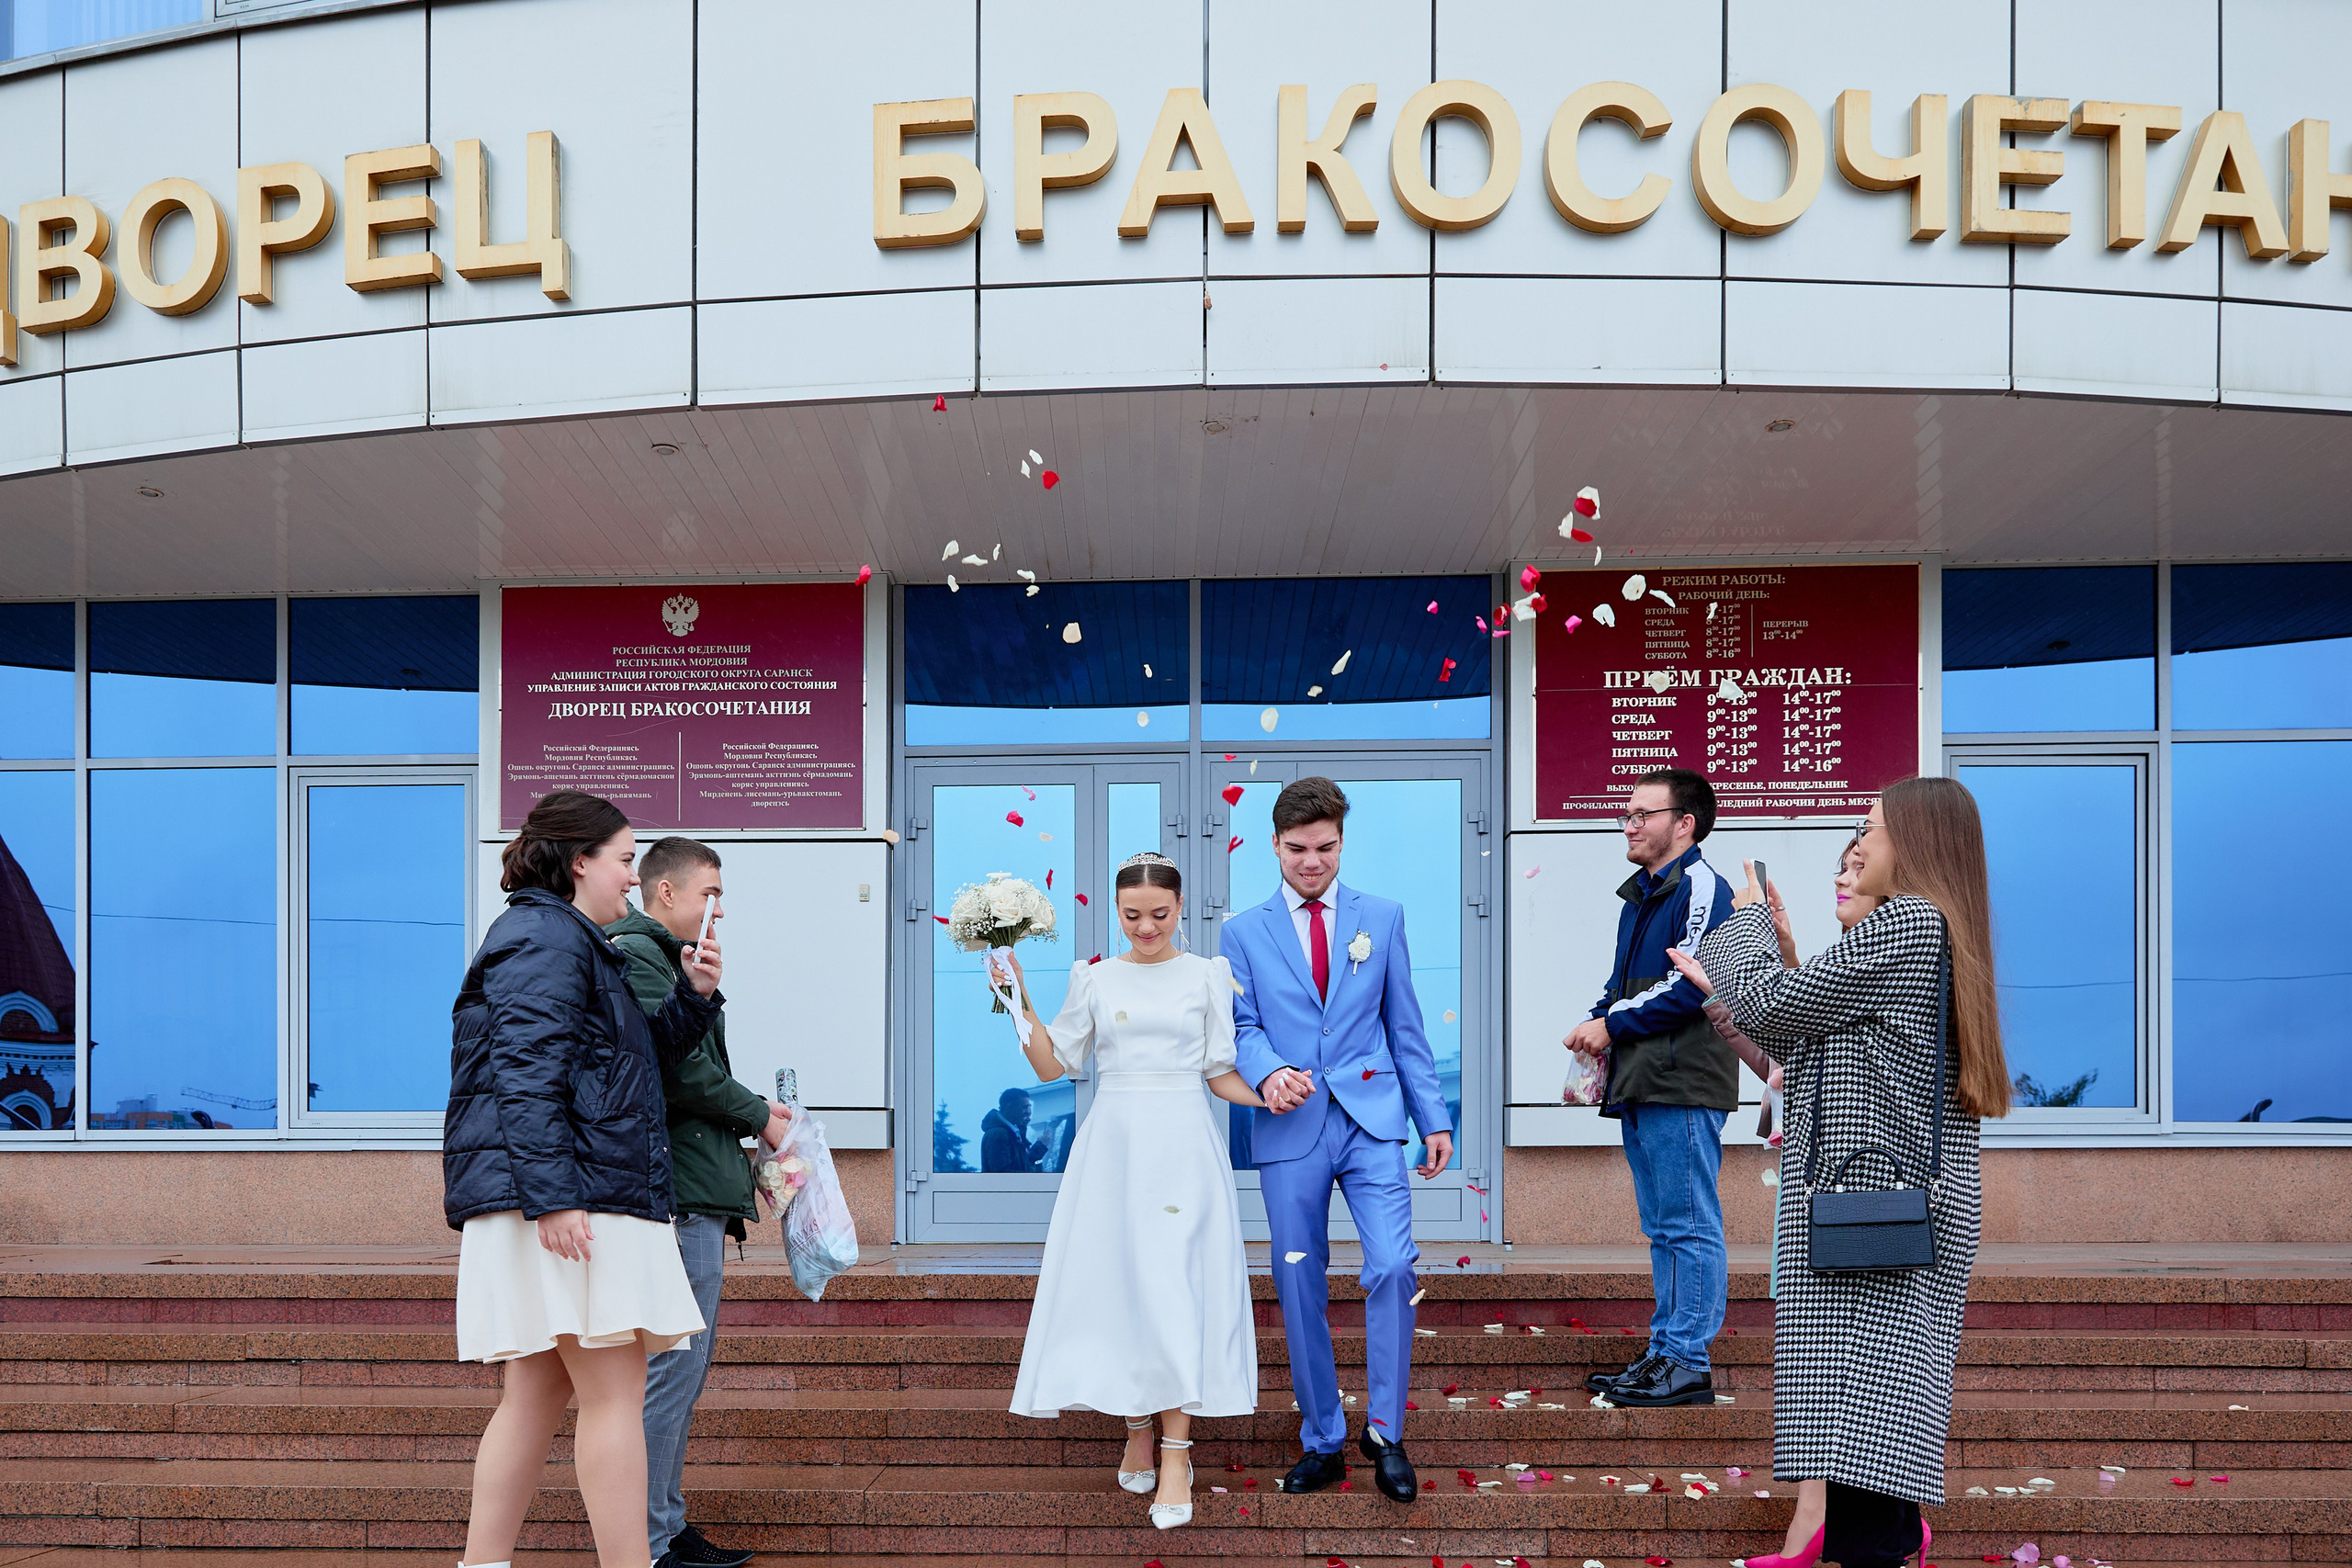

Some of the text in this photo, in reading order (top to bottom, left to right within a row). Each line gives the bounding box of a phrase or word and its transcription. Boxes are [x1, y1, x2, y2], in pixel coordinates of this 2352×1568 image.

[1663, 574, 1785, 585] РЕЖИМ РАБОТЫ:
[1679, 590, 1770, 600] РАБОЧИЙ ДЕНЬ:
[613, 645, 751, 654] РОССИЙСКАЯ ФЕДЕРАЦИЯ
[690, 658, 747, 666] МОРДОВИЯ
[551, 671, 646, 680] АДМИНИСТРАЦИЯ
[650, 671, 718, 679] ГОРОДСКОГО
[683, 682, 767, 691] ГРАЖДАНСКОГО
[1612, 697, 1677, 706] ВТОРНИК
[548, 701, 811, 719] ДВОРЕЦ БРАКОСОЧЕТАНИЯ
[1611, 715, 1656, 726] СРЕДА
[1612, 731, 1672, 740] ЧЕТВЕРГ
[1612, 748, 1678, 759] ПЯТНИЦА
[1769, 781, 1848, 790] ПОНЕДЕЛЬНИК
[1563, 802, 1627, 810] ПРОФИЛАКТИ
[1817, 798, 1846, 808] ДЕНЬ
[1848, 797, 1880, 807] МЕСЯ
